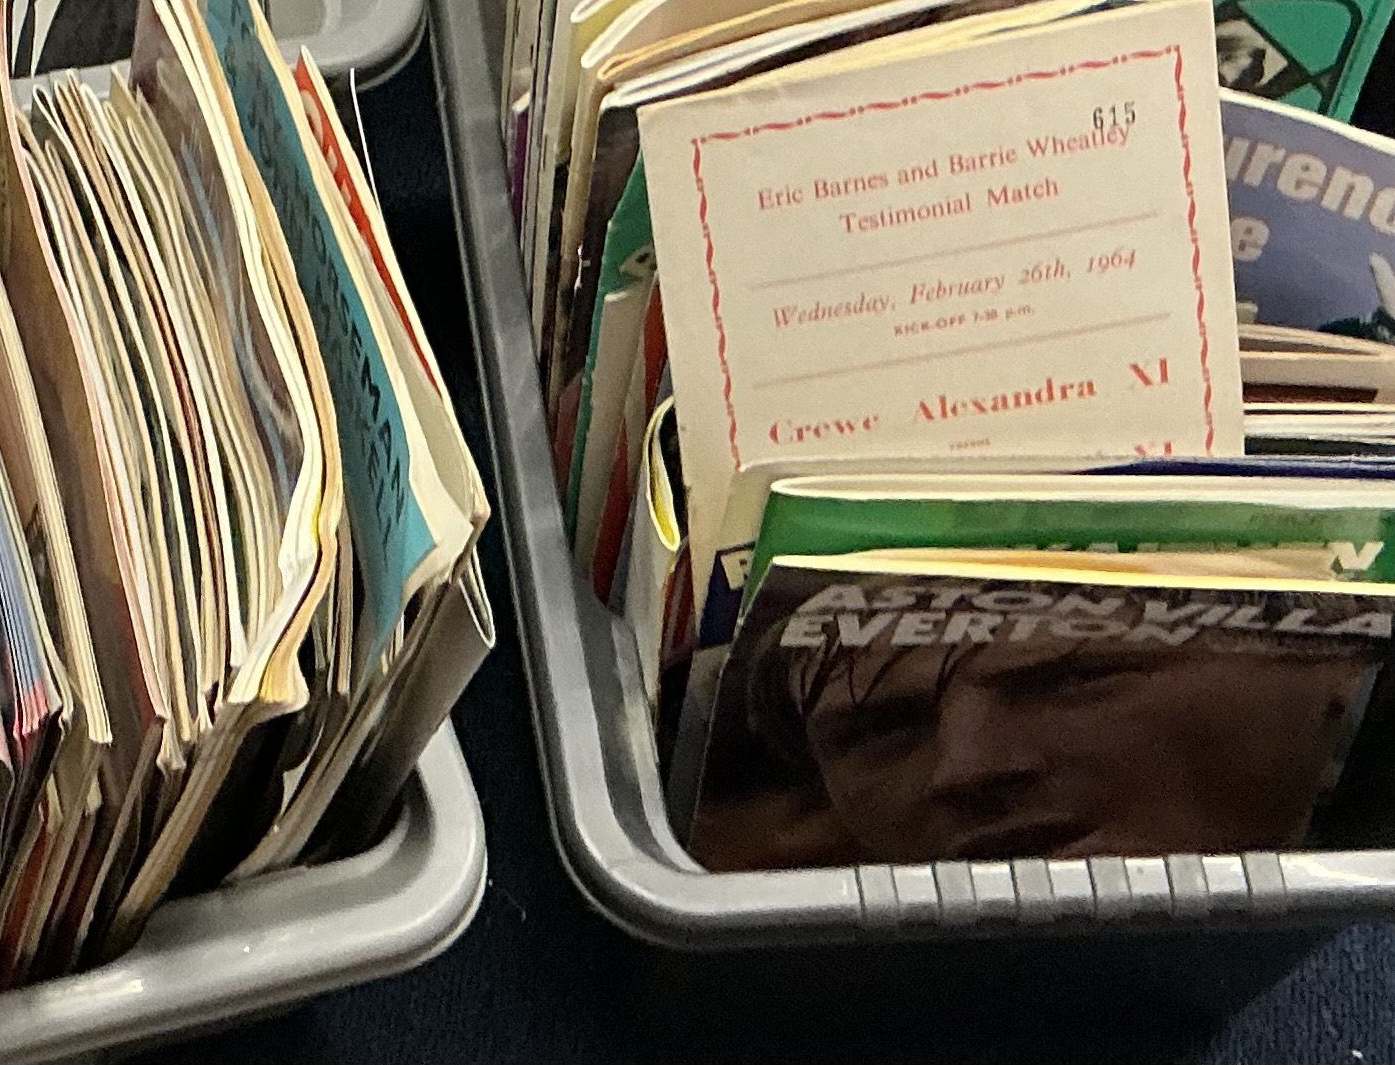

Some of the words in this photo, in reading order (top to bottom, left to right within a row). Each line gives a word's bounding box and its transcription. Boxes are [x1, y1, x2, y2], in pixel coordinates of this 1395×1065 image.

[1092, 102, 1137, 130] 615
[757, 187, 804, 211] Eric
[814, 172, 889, 200] Barnes
[897, 160, 939, 185] and
[948, 145, 1018, 174] Barrie
[1026, 122, 1132, 158] Wheatley
[838, 193, 973, 234] Testimonial
[987, 177, 1060, 208] Match
[771, 291, 897, 330] Wednesday,
[909, 271, 1005, 306] February
[1018, 258, 1072, 286] 26th,
[1087, 246, 1138, 274] 1964
[768, 413, 880, 446] Crewe
[912, 377, 1097, 423] Alexandra
[1129, 357, 1171, 387] XI
[779, 610, 1203, 649] EVERTON
[795, 583, 1125, 617] ASTON
[1142, 600, 1392, 638] VILLA
